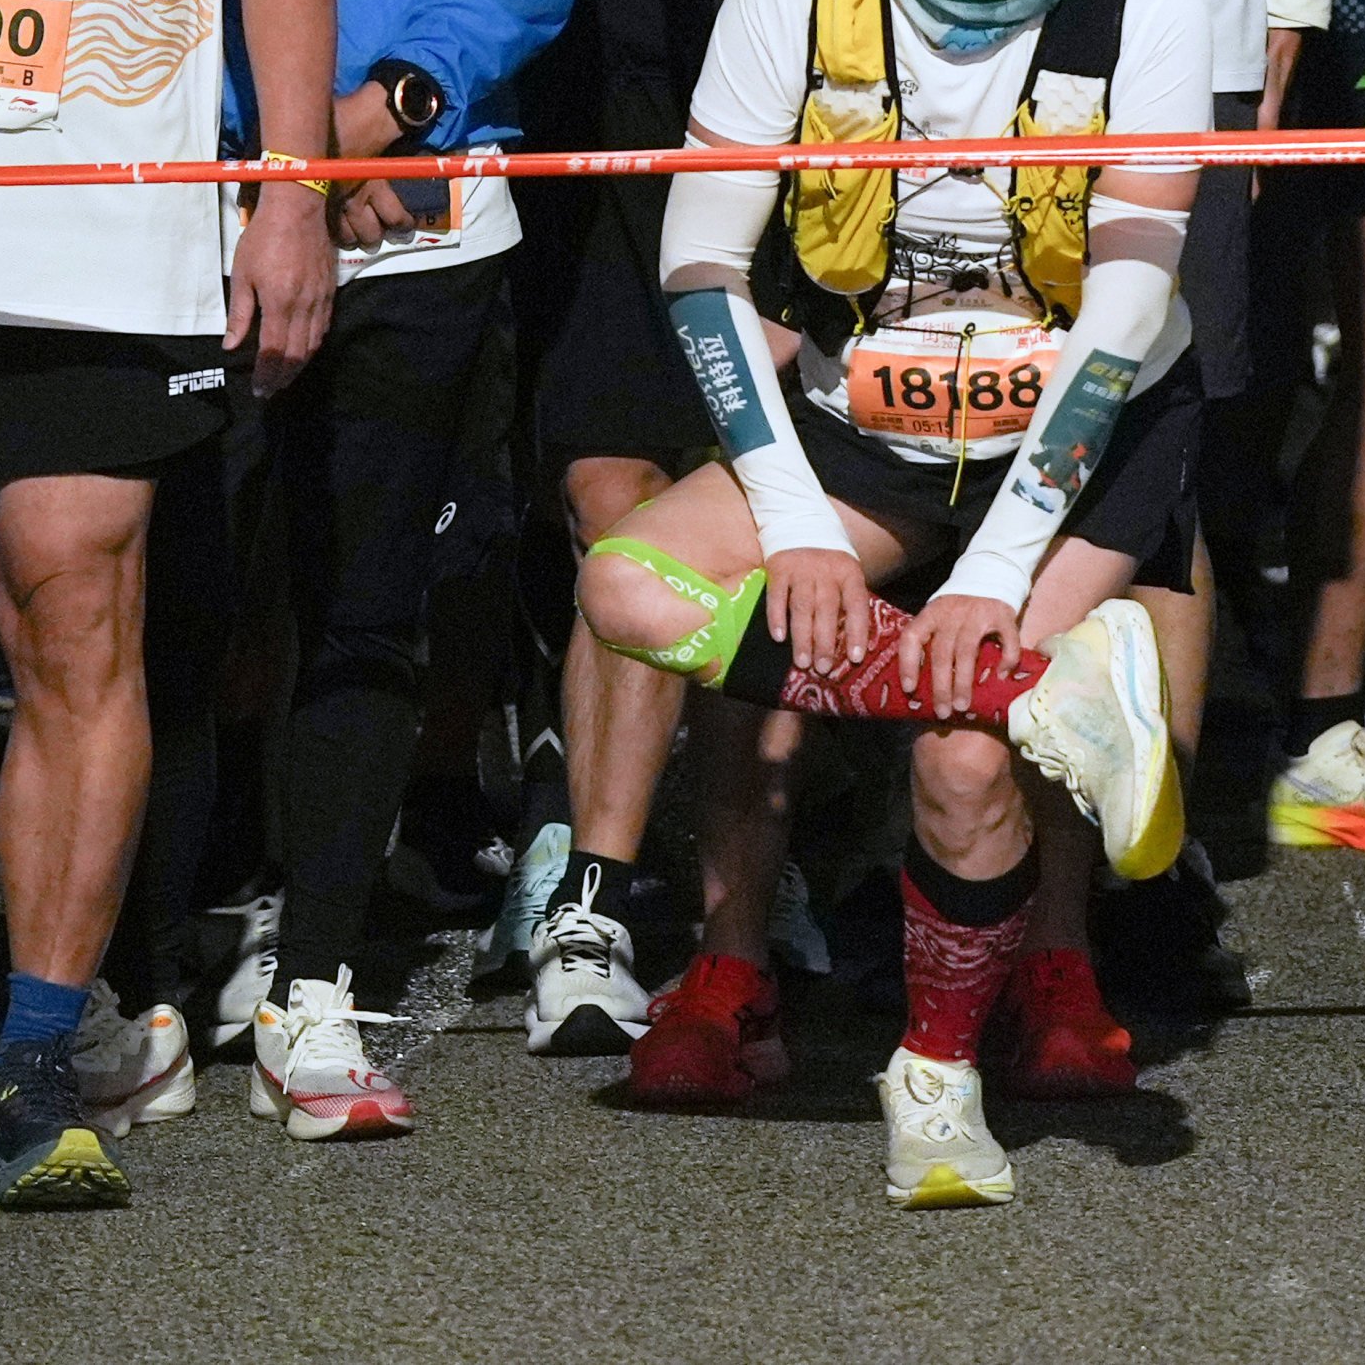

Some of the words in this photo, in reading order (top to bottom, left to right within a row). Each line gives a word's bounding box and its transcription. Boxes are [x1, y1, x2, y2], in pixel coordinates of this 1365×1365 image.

[22, 69, 34, 86] B
[698, 333, 748, 414] 科特拉
[873, 363, 1043, 411] 18188
